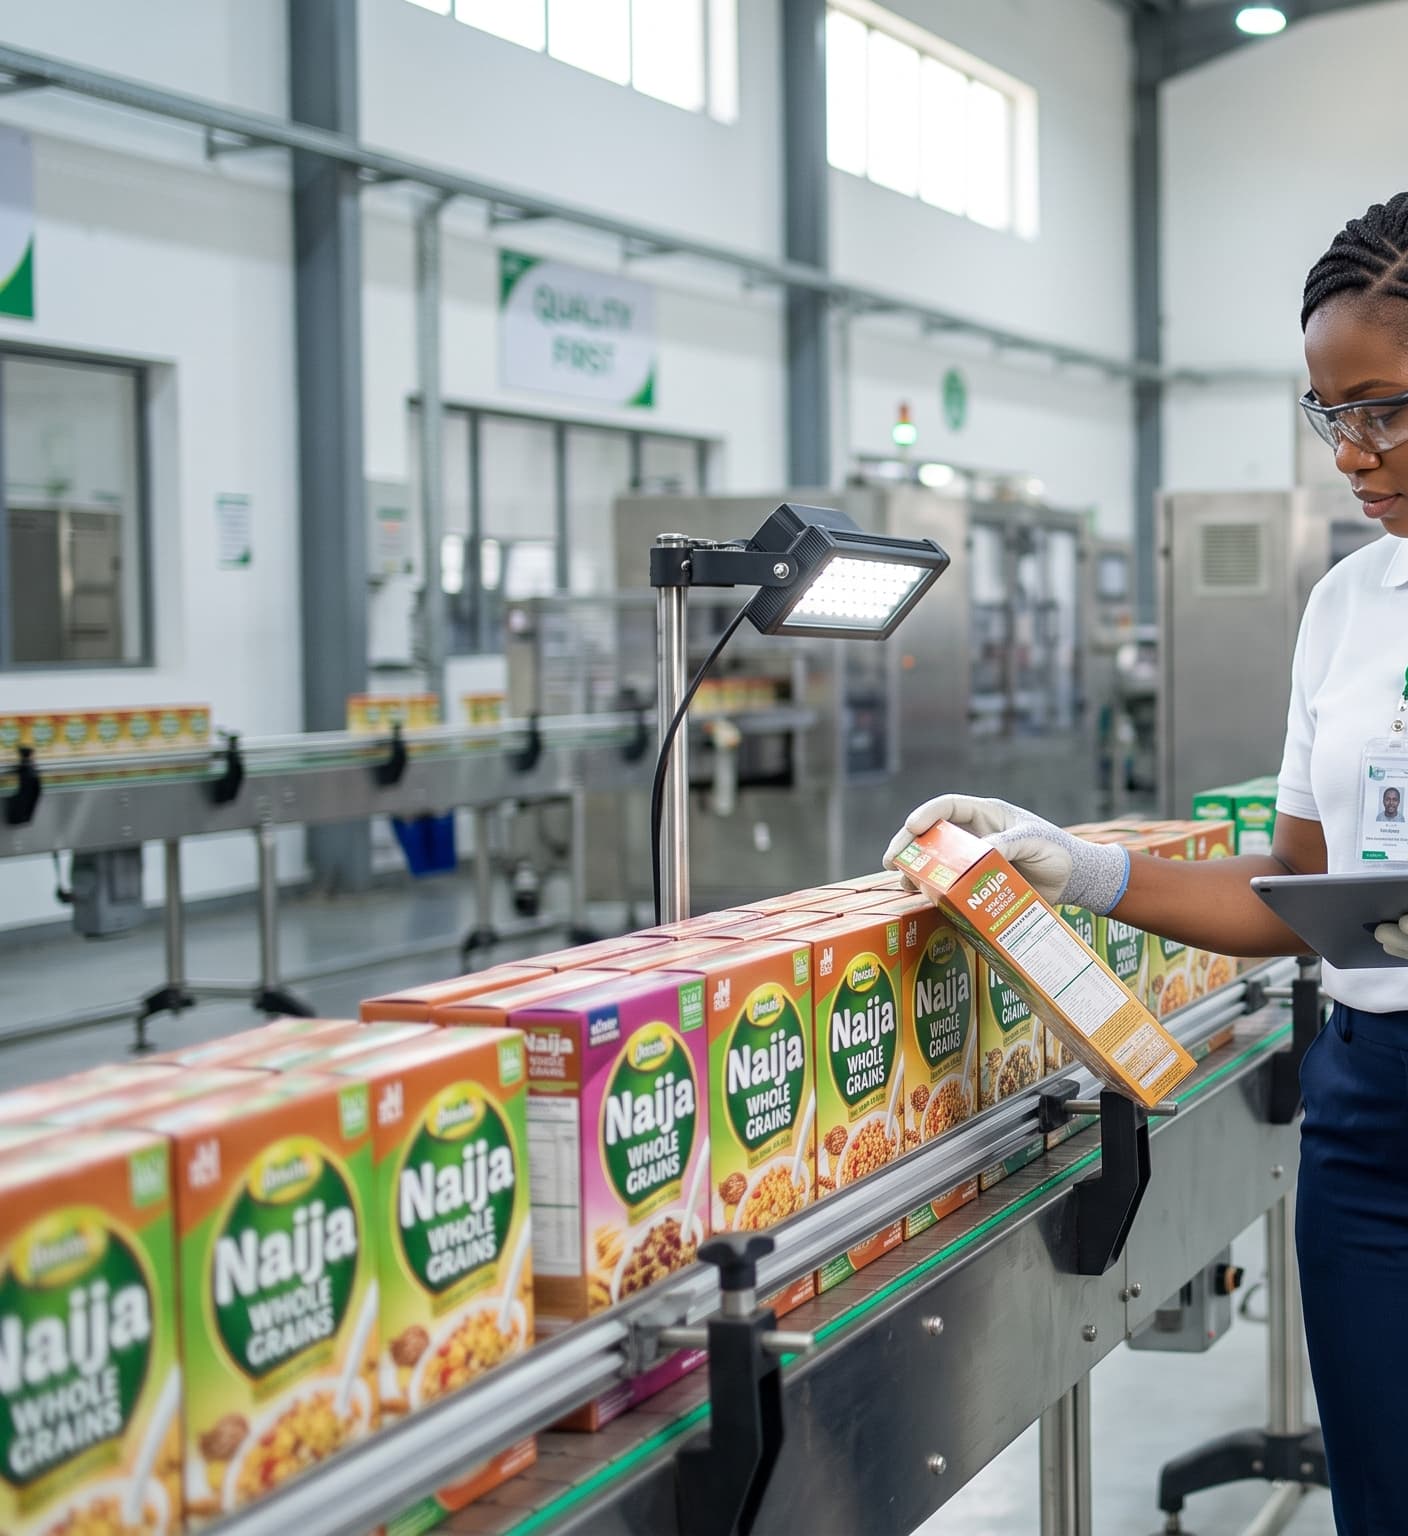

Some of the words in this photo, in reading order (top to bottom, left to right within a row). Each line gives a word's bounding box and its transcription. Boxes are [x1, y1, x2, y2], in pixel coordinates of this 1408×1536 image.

[916, 968, 970, 1019] Naija
[832, 995, 895, 1053] Naija
[929, 1013, 961, 1040] WHOLE
[728, 1028, 804, 1095] Naija
[846, 1065, 886, 1097] GRAINS
[847, 1045, 885, 1075] WHOLE
[605, 1071, 695, 1146] Naija
[745, 1105, 792, 1141] GRAINS
[746, 1083, 791, 1117] WHOLE
[626, 1154, 681, 1195] GRAINS
[627, 1130, 680, 1170] WHOLE
[400, 1138, 516, 1230] Naija
[215, 1199, 358, 1307] Naija
[427, 1206, 496, 1253] WHOLE
[426, 1234, 498, 1284] GRAINS
[247, 1276, 333, 1333] WHOLE
[246, 1306, 335, 1367] GRAINS
[10, 1365, 120, 1436] WHOLE
[9, 1400, 122, 1475] GRAINS
